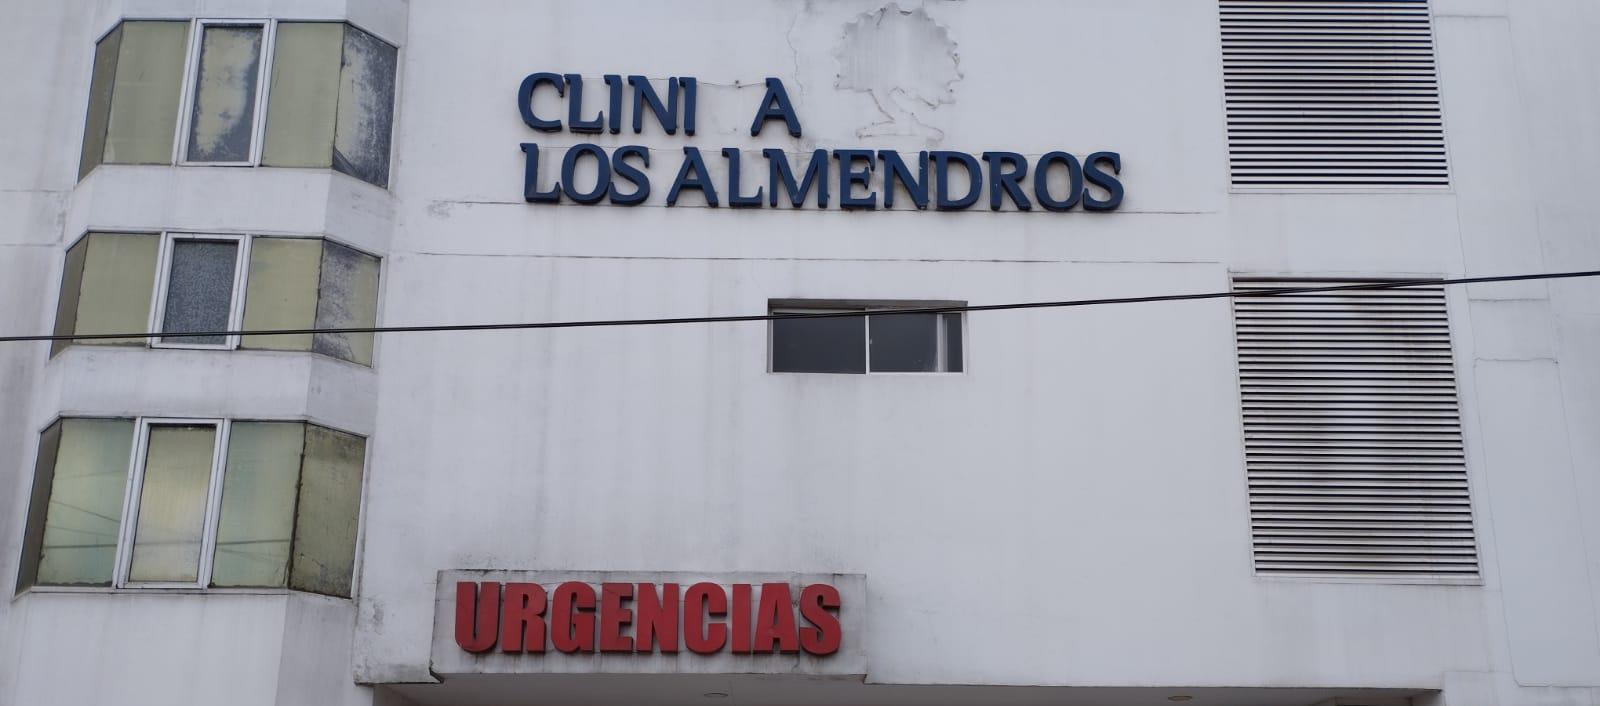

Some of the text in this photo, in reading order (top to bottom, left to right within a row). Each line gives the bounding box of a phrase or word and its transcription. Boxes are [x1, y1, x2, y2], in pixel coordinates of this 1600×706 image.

[520, 142, 1125, 211] LOS ALMENDROS
[454, 581, 842, 657] URGENCIAS
